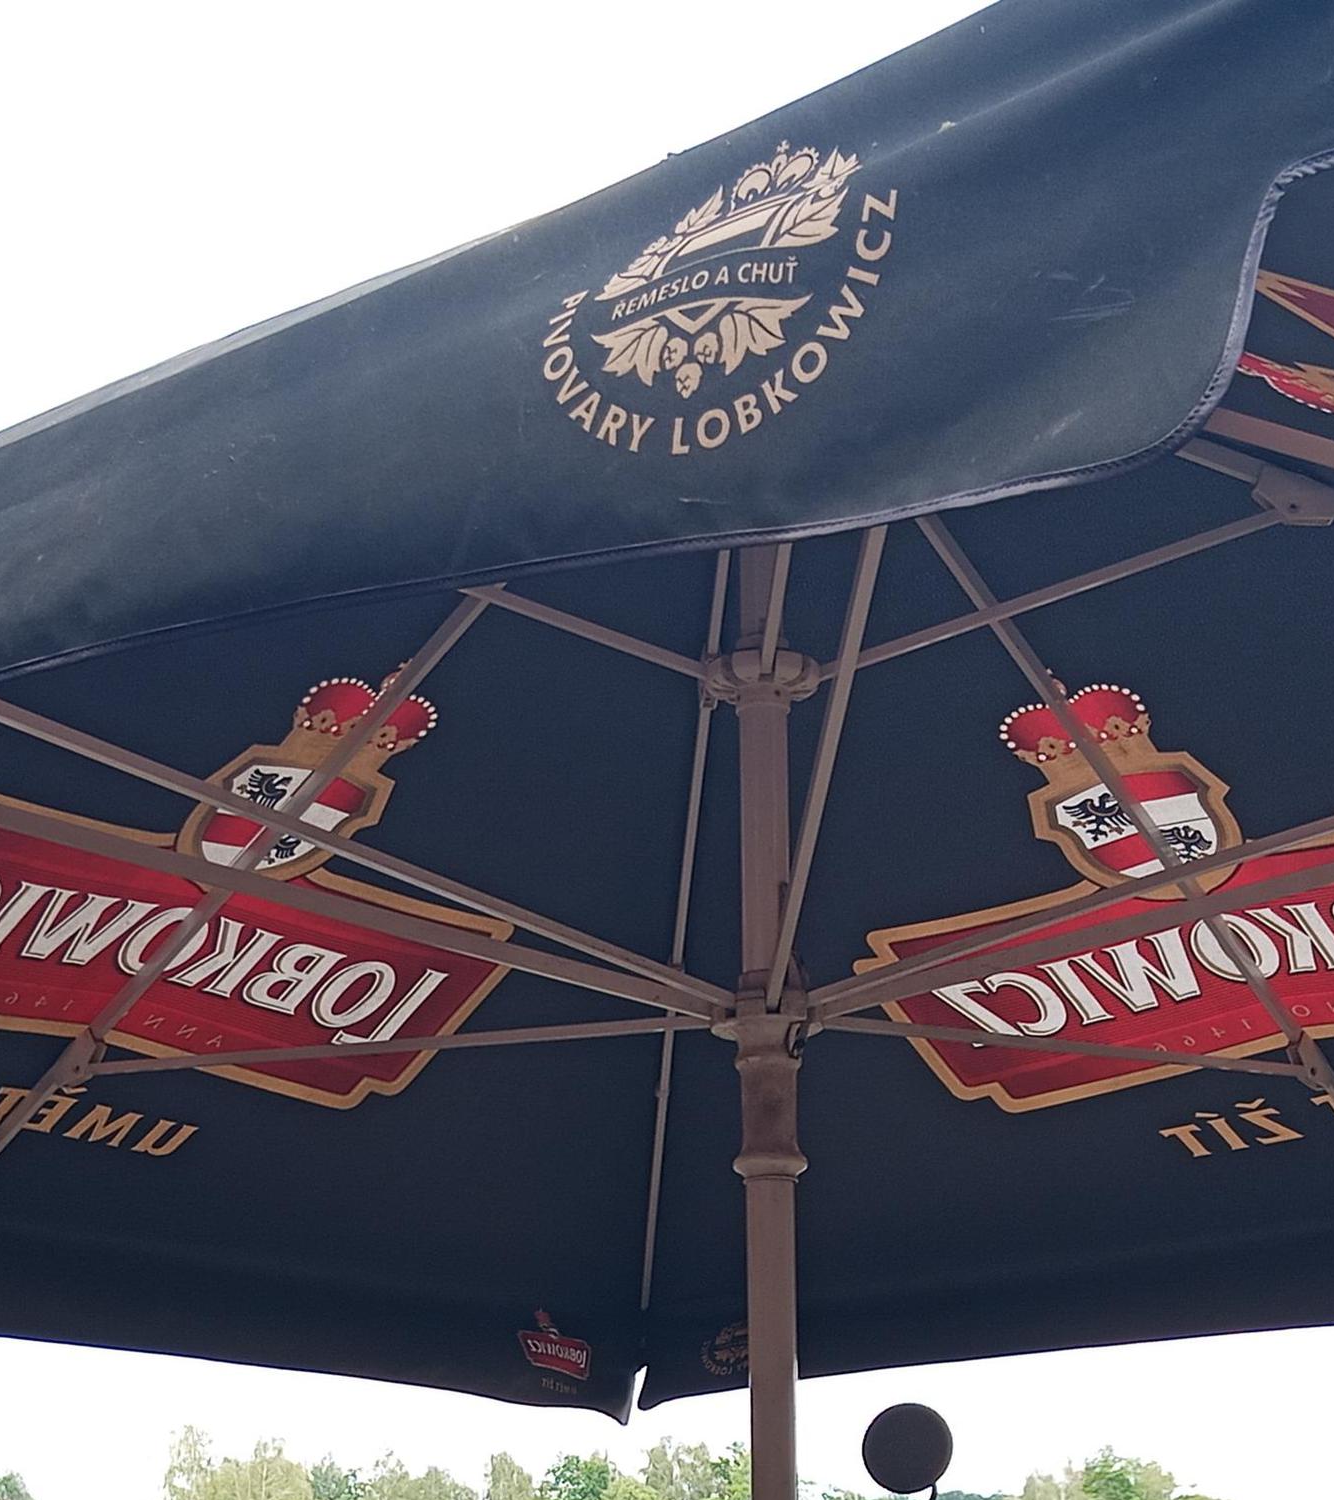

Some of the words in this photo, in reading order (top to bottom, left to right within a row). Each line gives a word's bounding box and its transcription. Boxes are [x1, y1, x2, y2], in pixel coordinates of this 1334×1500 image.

[543, 289, 655, 453] PIVOVARY
[671, 189, 898, 455] LOBKOWICZ
[611, 269, 709, 321] ŘEMESLO
[715, 264, 729, 284] A
[738, 255, 799, 284] CHUŤ
